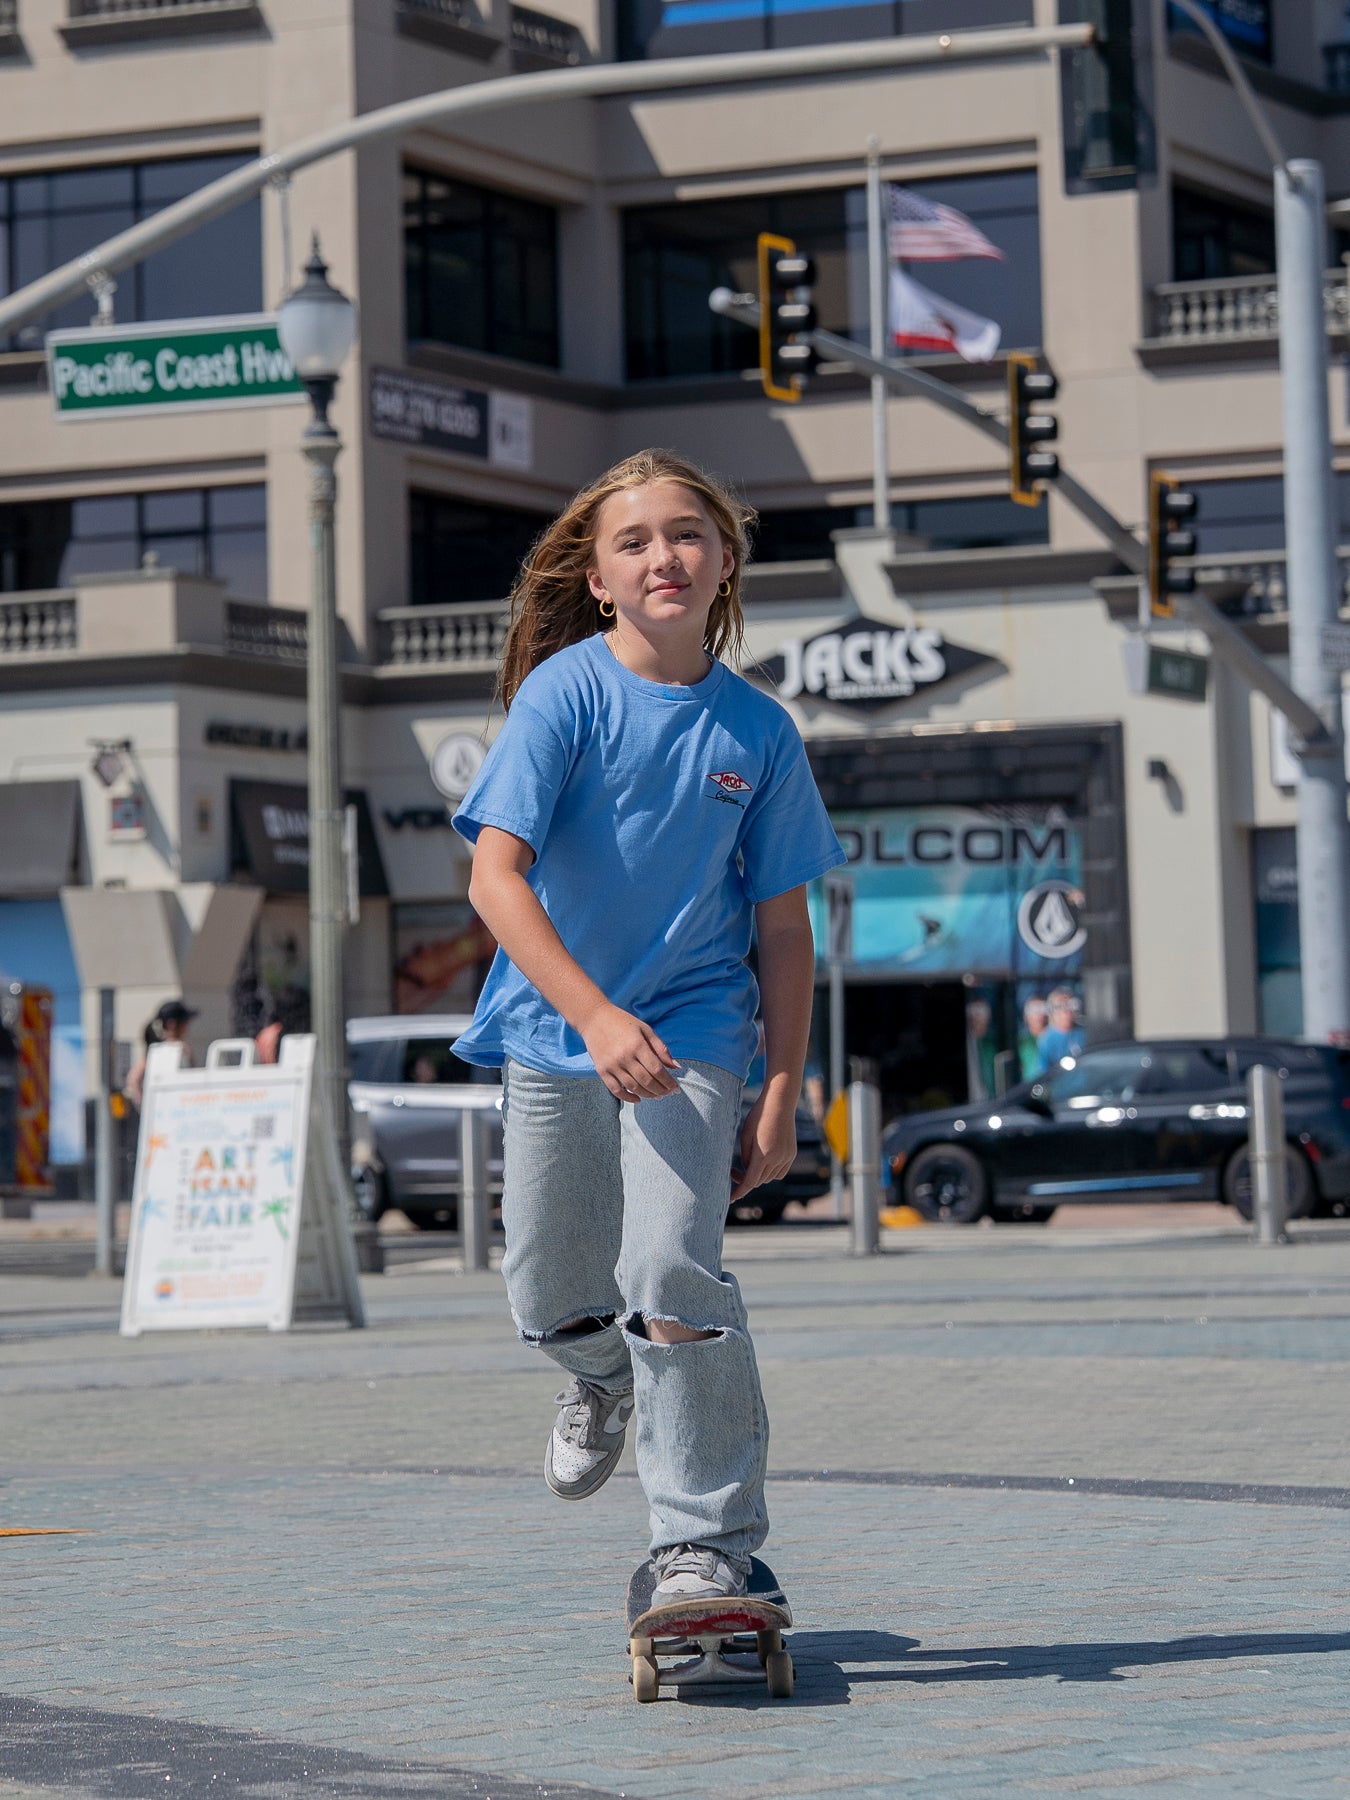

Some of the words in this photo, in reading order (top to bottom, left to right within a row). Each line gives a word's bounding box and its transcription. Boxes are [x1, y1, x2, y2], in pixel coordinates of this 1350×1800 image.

[54, 351, 154, 399] Pacific
[155, 348, 240, 391] Coast
[241, 341, 296, 384] Hw
[835, 827, 1067, 862] OLCOM
[193, 1145, 257, 1172] ART
[187, 1202, 254, 1228] FAIR
